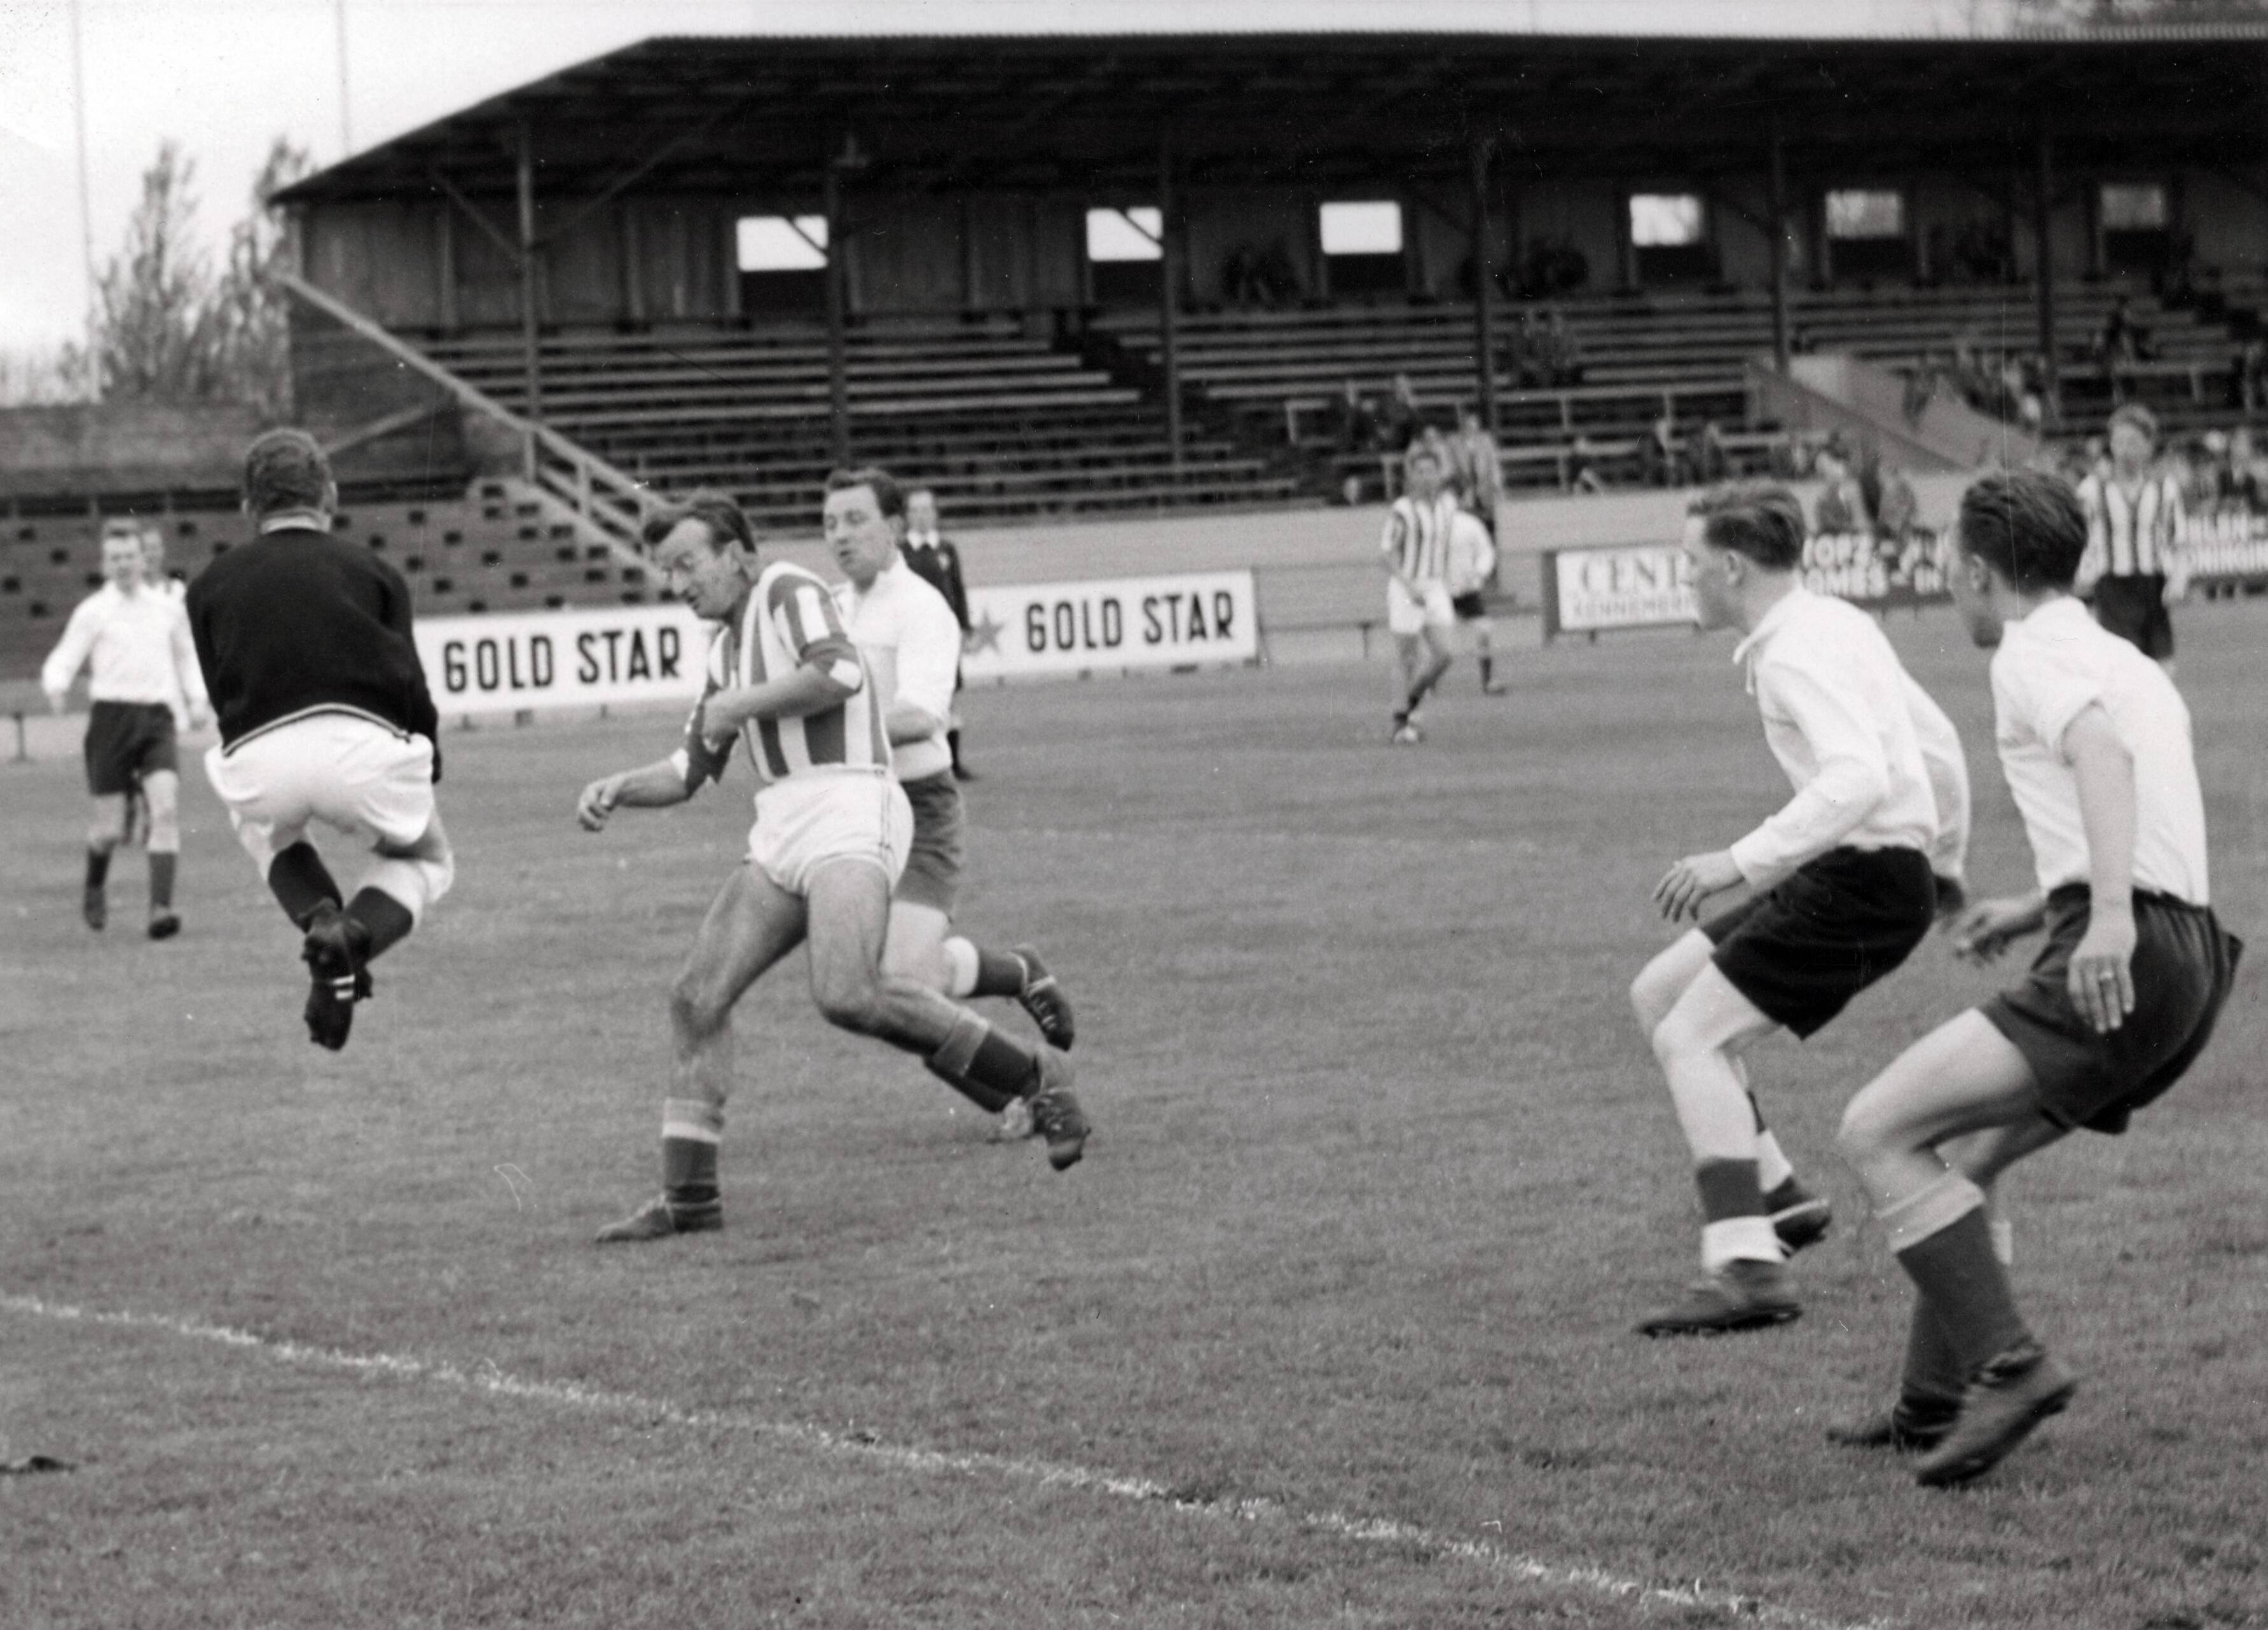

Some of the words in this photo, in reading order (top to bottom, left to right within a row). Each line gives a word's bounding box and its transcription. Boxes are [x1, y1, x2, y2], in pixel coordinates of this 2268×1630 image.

[1026, 597, 1122, 652] GOLD
[1143, 591, 1234, 645] STAR
[444, 636, 554, 693] GOLD
[577, 626, 680, 685] STAR
